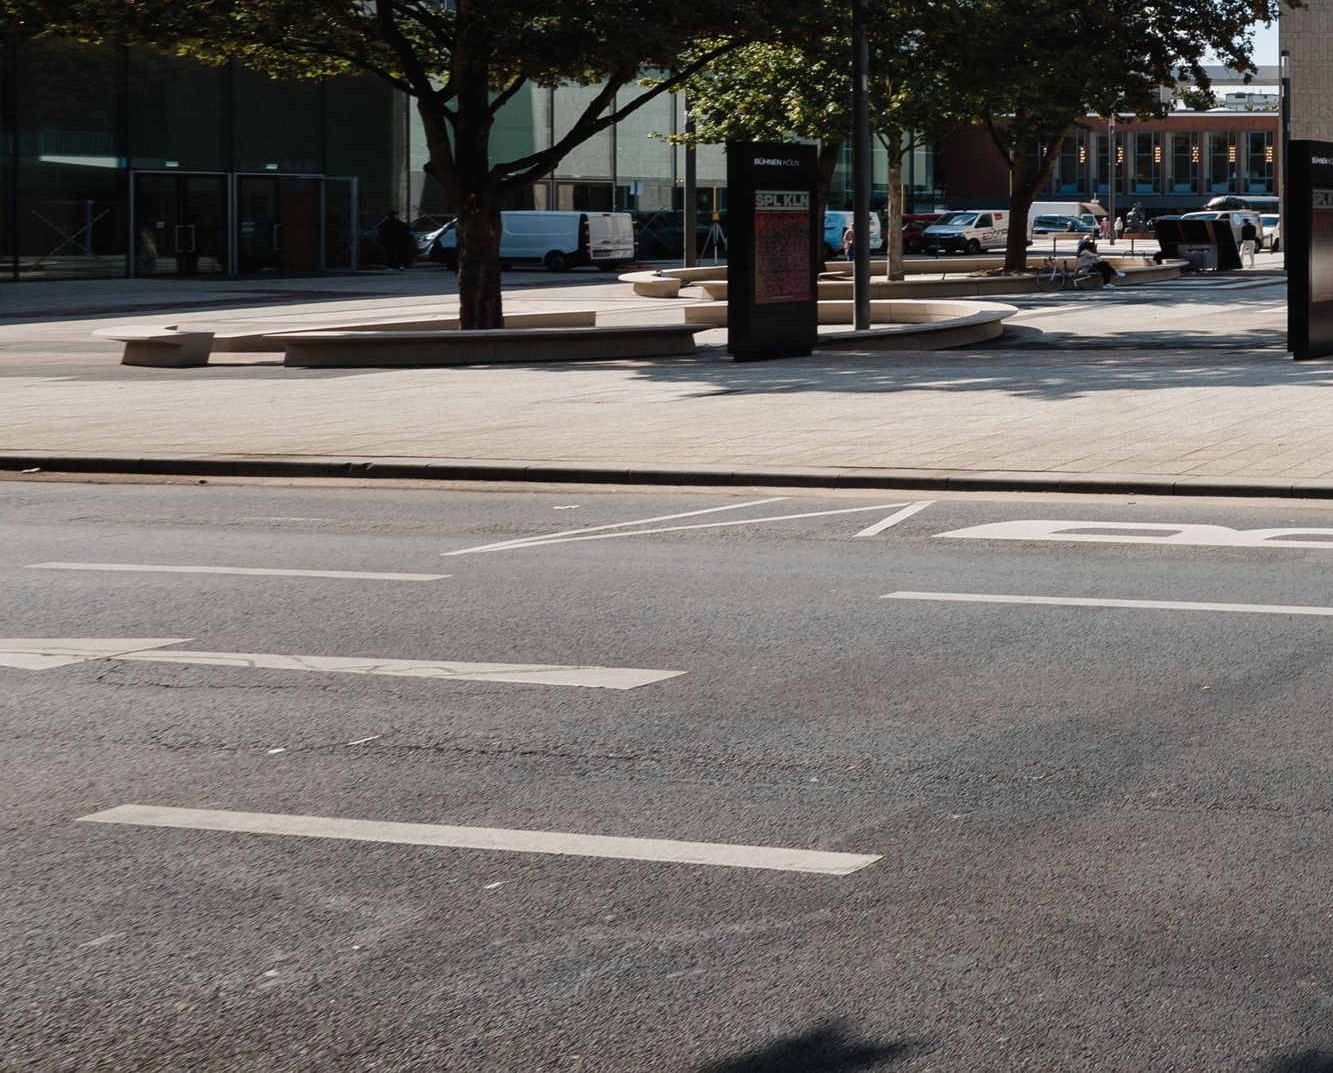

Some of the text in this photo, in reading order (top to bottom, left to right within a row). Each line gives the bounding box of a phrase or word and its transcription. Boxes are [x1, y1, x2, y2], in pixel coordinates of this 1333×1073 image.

[754, 157, 782, 165] BÜHNEN
[755, 194, 809, 207] SPL KLN
